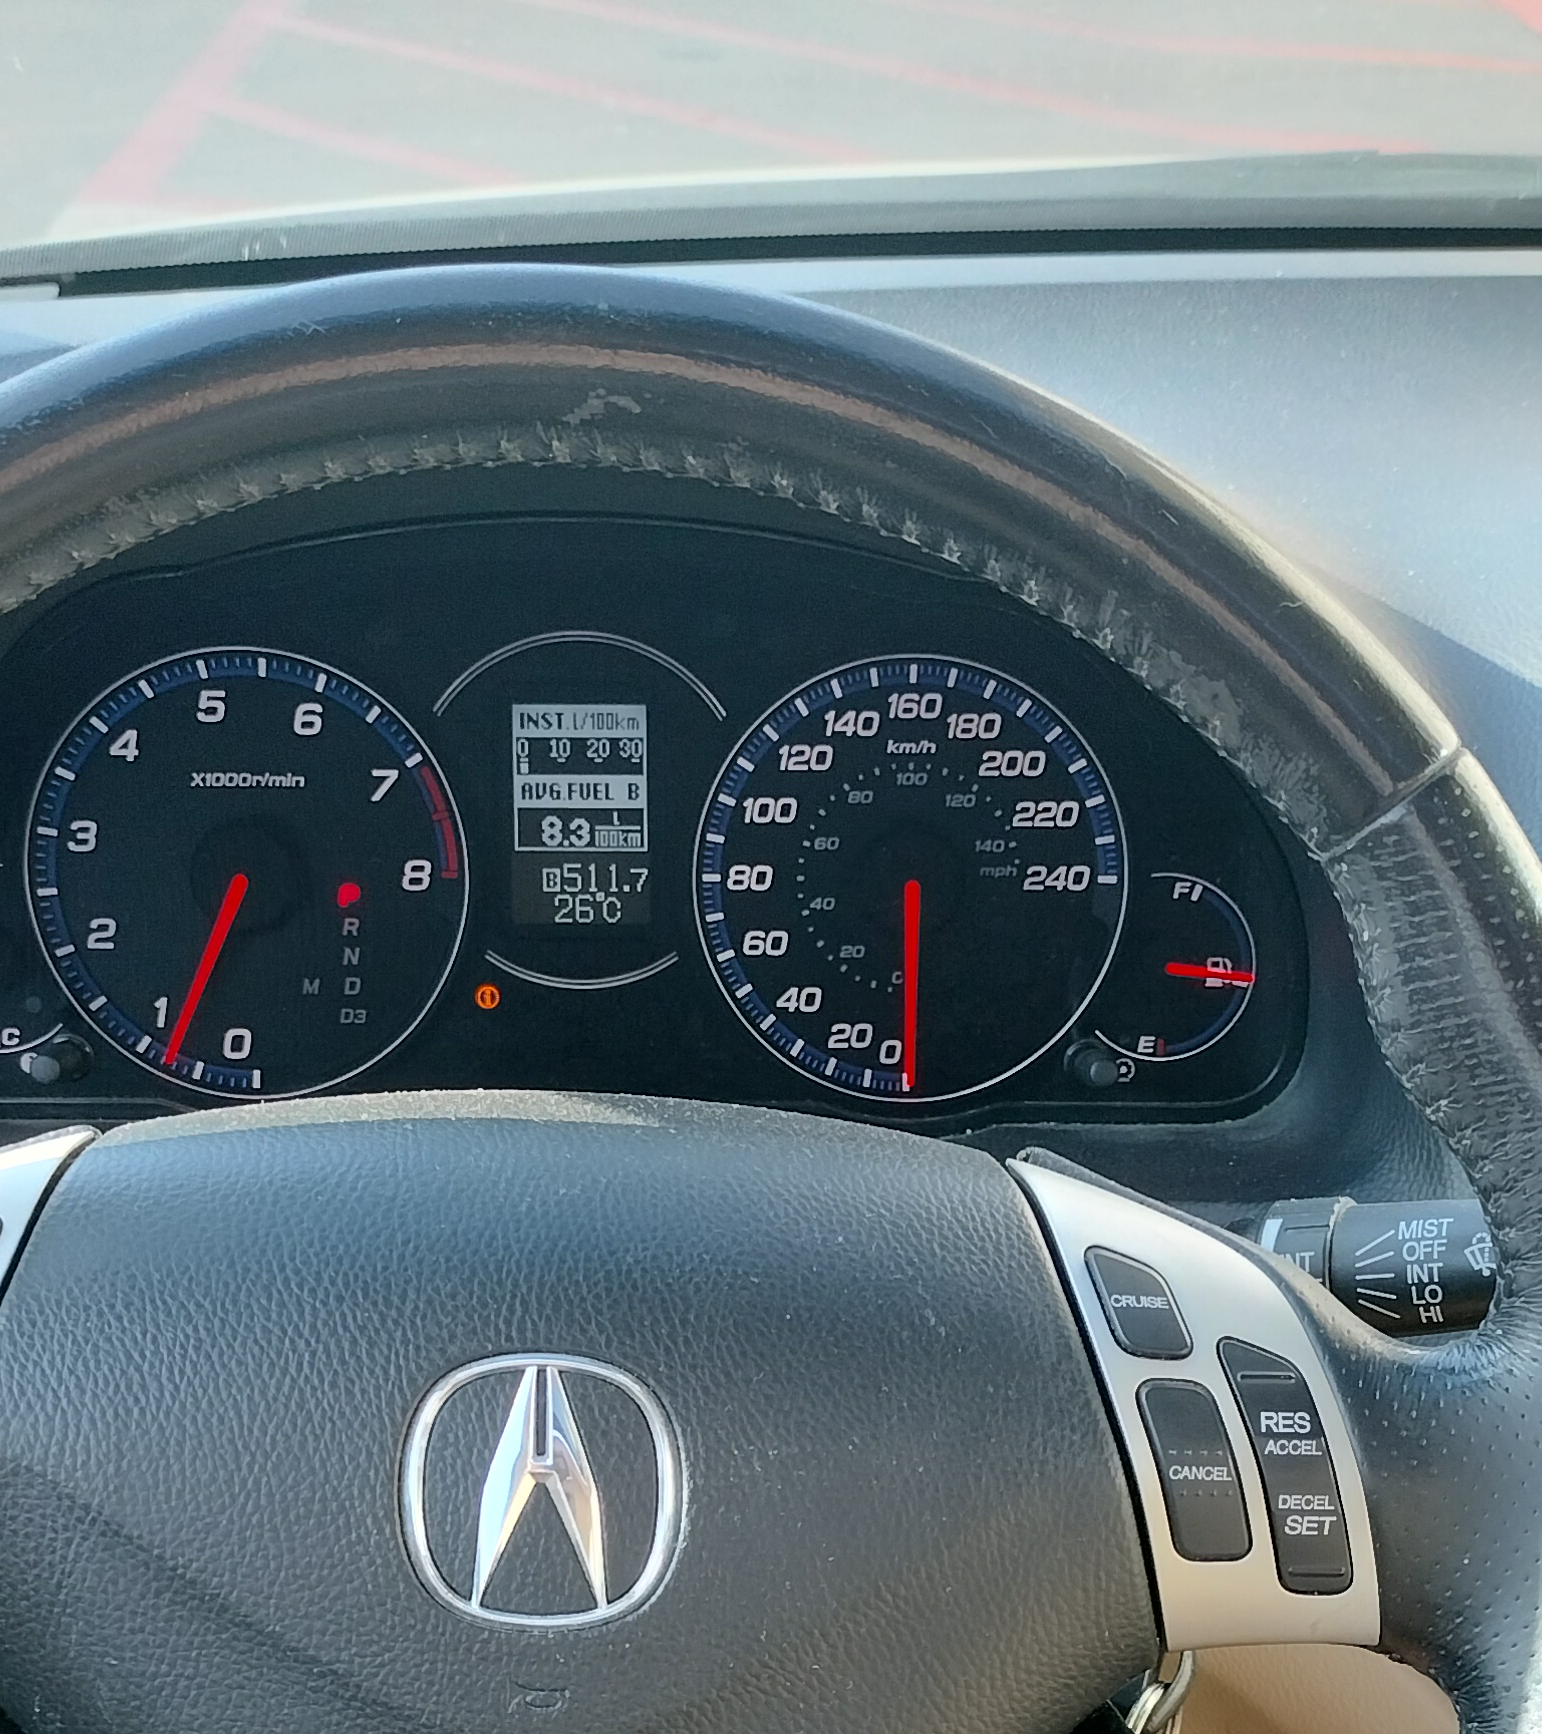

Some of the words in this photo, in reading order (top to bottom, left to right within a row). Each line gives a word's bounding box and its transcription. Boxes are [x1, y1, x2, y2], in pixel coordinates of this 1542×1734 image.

[196, 691, 227, 724] 5
[887, 693, 943, 720] 160
[292, 703, 324, 736] 6
[824, 711, 880, 738] 140
[946, 713, 1002, 739] 180
[109, 729, 140, 762] 4
[517, 739, 529, 758] 0
[550, 739, 571, 758] 10
[587, 739, 610, 758] 20
[619, 739, 643, 758] 30
[886, 739, 937, 757] km/h
[778, 744, 834, 770] 120
[978, 750, 1047, 777] 200
[369, 768, 400, 802] 7
[896, 772, 928, 786] 100
[627, 782, 641, 801] B
[847, 790, 873, 804] 80
[945, 794, 977, 808] 120
[742, 798, 798, 824] 100
[1012, 801, 1080, 828] 220
[67, 820, 99, 853] 3
[541, 815, 591, 848] 8.3
[595, 831, 641, 848] 100km
[814, 836, 840, 851] 60
[975, 839, 1005, 853] 140
[401, 859, 433, 892] 8
[726, 866, 773, 892] 80
[979, 865, 1017, 878] mph
[1022, 865, 1090, 891] 240
[337, 882, 361, 908] P
[1173, 883, 1190, 901] F
[554, 892, 621, 923] 26°C
[809, 897, 836, 911] 40
[87, 918, 117, 951] 2
[342, 917, 360, 936] R
[742, 931, 788, 957] 60
[839, 945, 865, 959] 20
[342, 947, 360, 965] N
[302, 978, 320, 995] M
[344, 977, 361, 995] D
[776, 987, 822, 1013] 40
[154, 997, 169, 1029] 1
[340, 1008, 367, 1024] D3
[223, 1027, 254, 1060] 0
[828, 1023, 873, 1050] 20
[1137, 1036, 1156, 1054] E
[879, 1039, 902, 1065] 0
[1397, 1218, 1454, 1240] MIST
[1402, 1239, 1447, 1261] OFF
[1406, 1263, 1444, 1284] INT
[1110, 1294, 1170, 1310] CRUISE
[1410, 1285, 1443, 1306] LO
[1419, 1305, 1444, 1324] HI
[1259, 1412, 1311, 1433] RES
[1264, 1440, 1323, 1456] ACCEL
[1168, 1465, 1233, 1481] CANCEL
[1278, 1495, 1336, 1511] DECEL
[1283, 1515, 1338, 1536] SET
